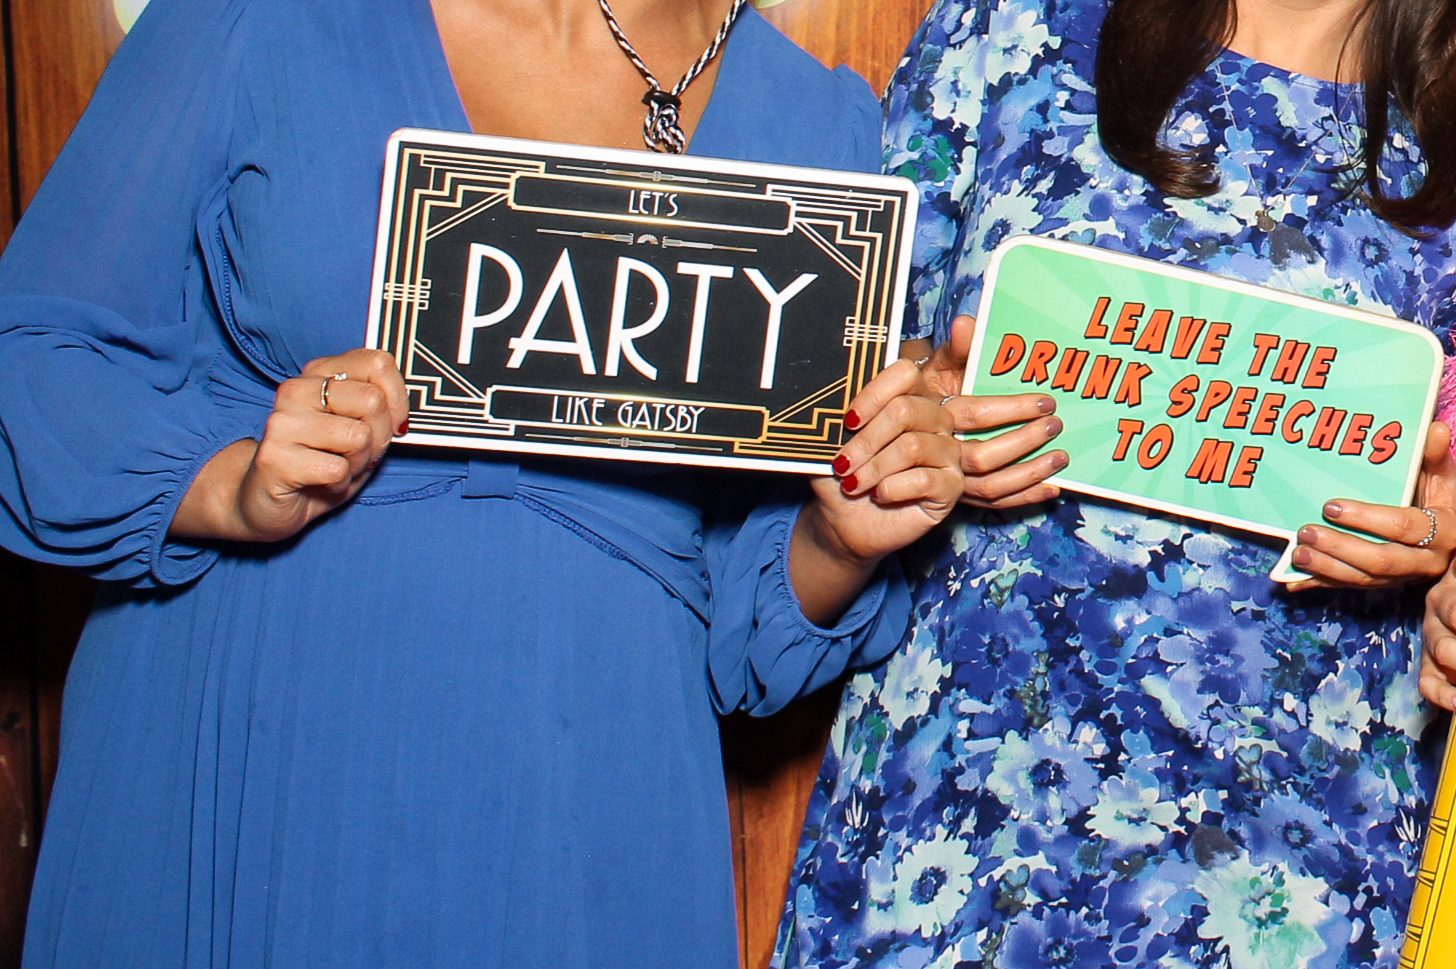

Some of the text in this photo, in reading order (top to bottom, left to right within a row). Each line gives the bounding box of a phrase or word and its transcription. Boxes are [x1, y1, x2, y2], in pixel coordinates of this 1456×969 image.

[628, 190, 680, 216] LET'S
[457, 242, 819, 390] PARTY
[1084, 296, 1338, 389] LEAVE THE
[552, 396, 706, 434] LIKE GATSBY
[989, 333, 1403, 465] DRUNK SPEECHES
[1111, 418, 1264, 489] TO ME
